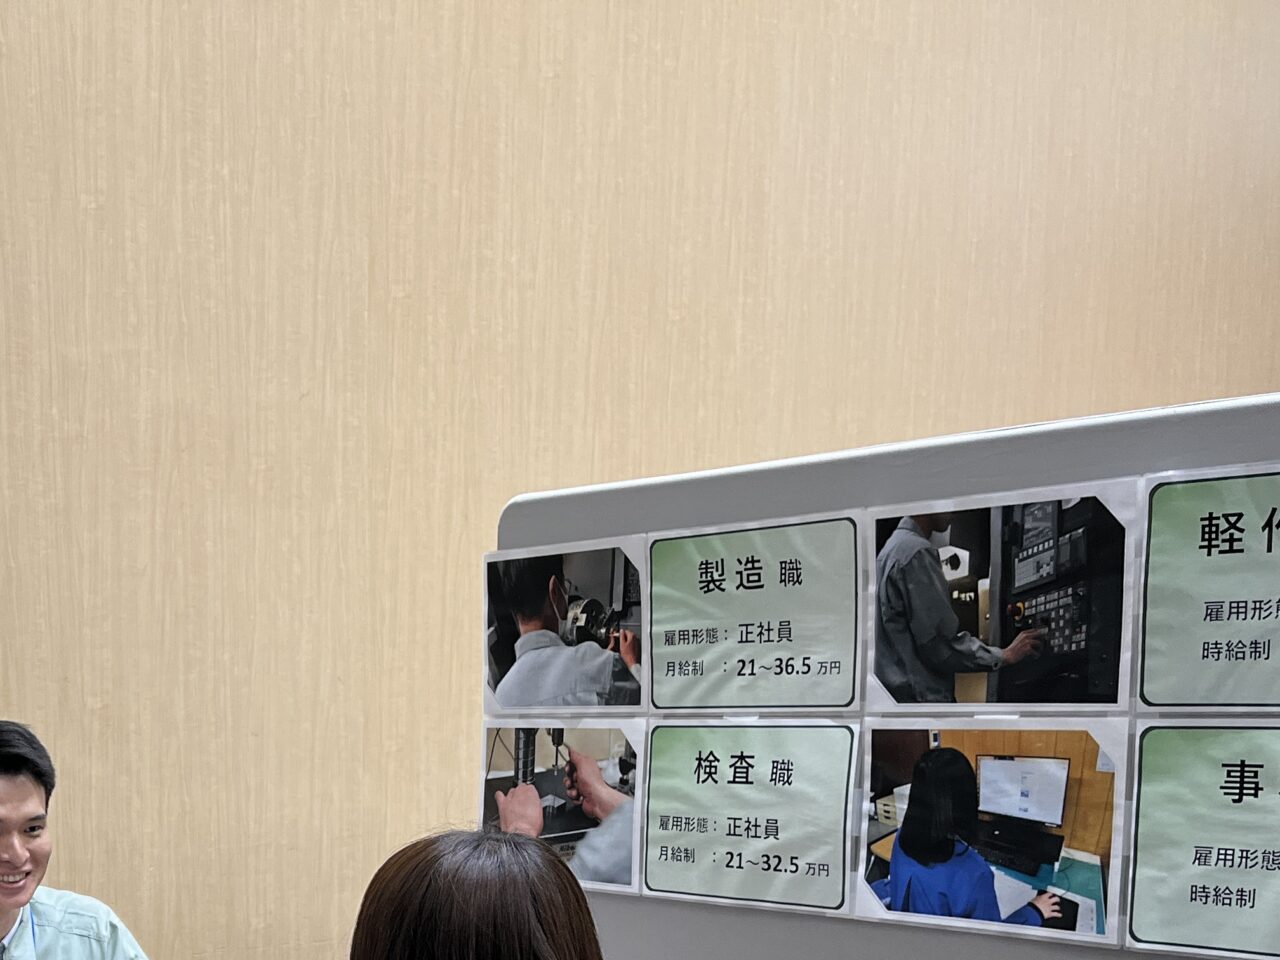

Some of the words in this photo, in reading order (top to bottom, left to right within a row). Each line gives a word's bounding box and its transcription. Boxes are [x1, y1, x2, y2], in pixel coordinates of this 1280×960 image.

[1203, 598, 1280, 622] 雇用形
[1202, 639, 1271, 661] 時給制
[1220, 759, 1280, 804] 事
[1190, 884, 1256, 909] 時給制
